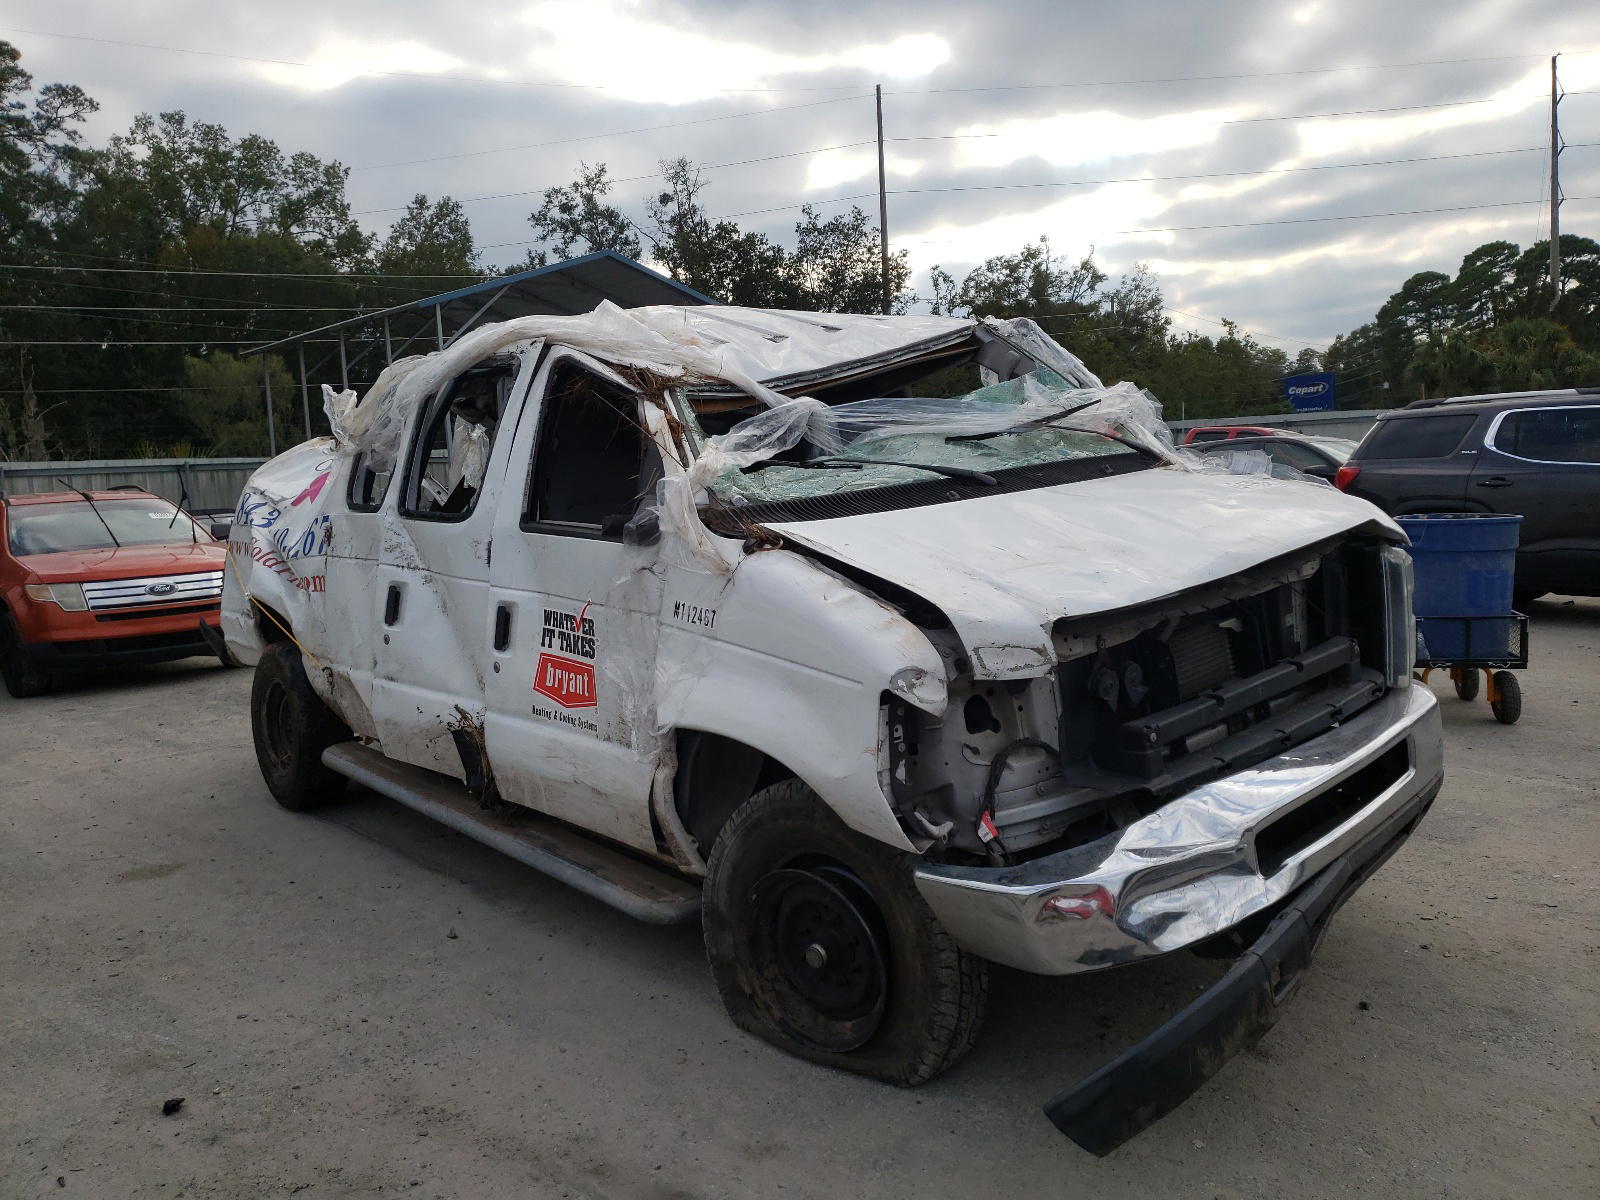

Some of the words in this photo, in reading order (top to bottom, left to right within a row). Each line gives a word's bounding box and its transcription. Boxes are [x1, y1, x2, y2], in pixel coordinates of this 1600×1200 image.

[1288, 384, 1324, 395] Copart
[543, 602, 595, 637] WHATEVER
[541, 627, 556, 648] IT
[558, 632, 596, 660] TAKES
[545, 663, 589, 697] bryant
[532, 705, 552, 720] Heating
[577, 717, 598, 732] Systems
